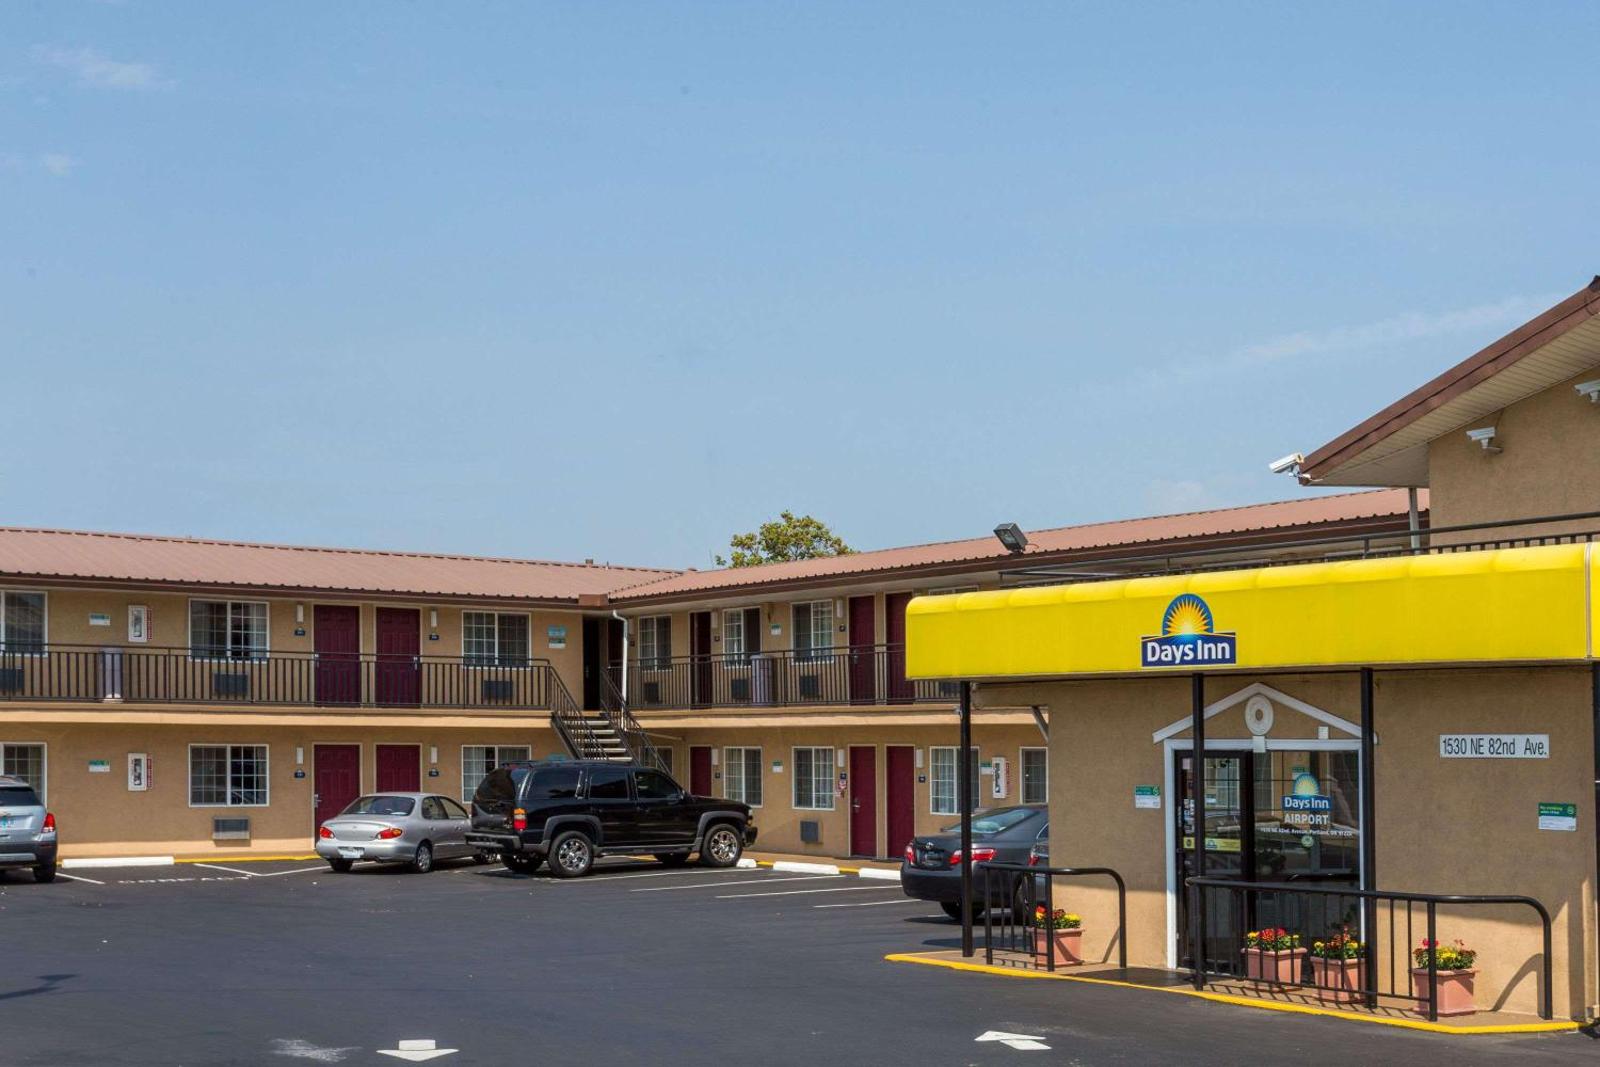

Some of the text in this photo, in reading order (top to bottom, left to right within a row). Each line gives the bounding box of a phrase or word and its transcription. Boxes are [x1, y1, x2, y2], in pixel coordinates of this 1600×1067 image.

[1147, 640, 1230, 664] Days Inn
[1443, 738, 1547, 755] 1530 NE 82nd Ave.
[1284, 797, 1329, 809] Days Inn
[1284, 813, 1329, 825] AIRPORT
